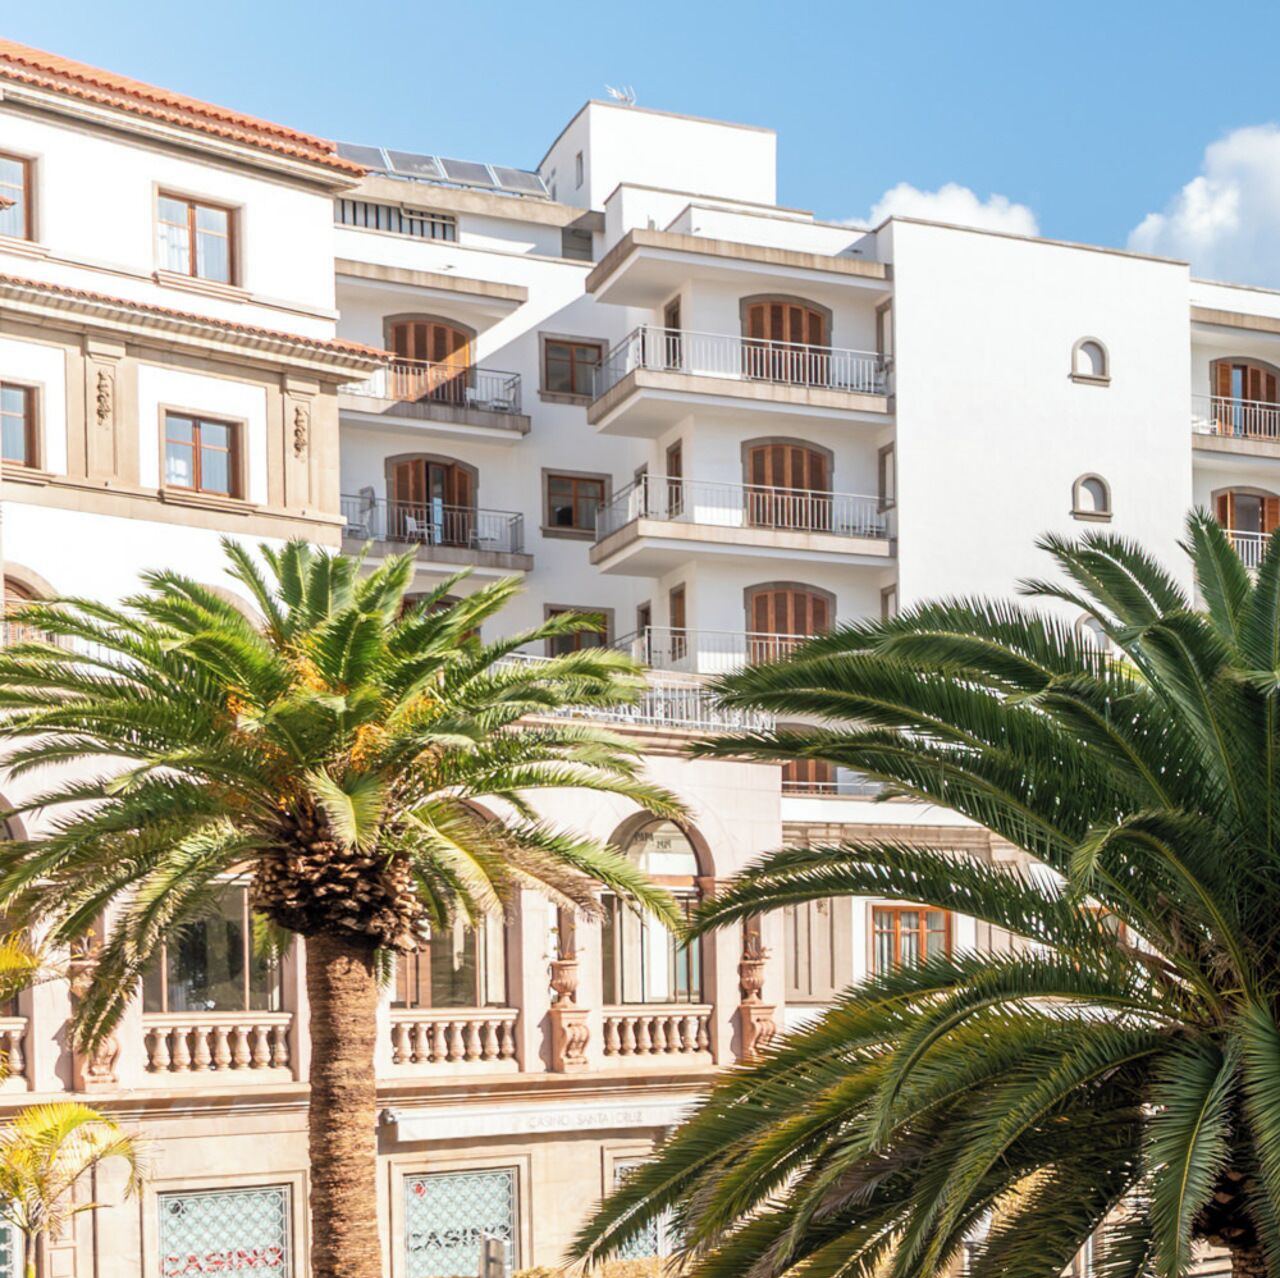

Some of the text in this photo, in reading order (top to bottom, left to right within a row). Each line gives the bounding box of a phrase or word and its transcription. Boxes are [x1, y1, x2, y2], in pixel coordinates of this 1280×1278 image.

[527, 1110, 644, 1129] CASINO SANTA CRUZ
[160, 1247, 283, 1278] CASINO
